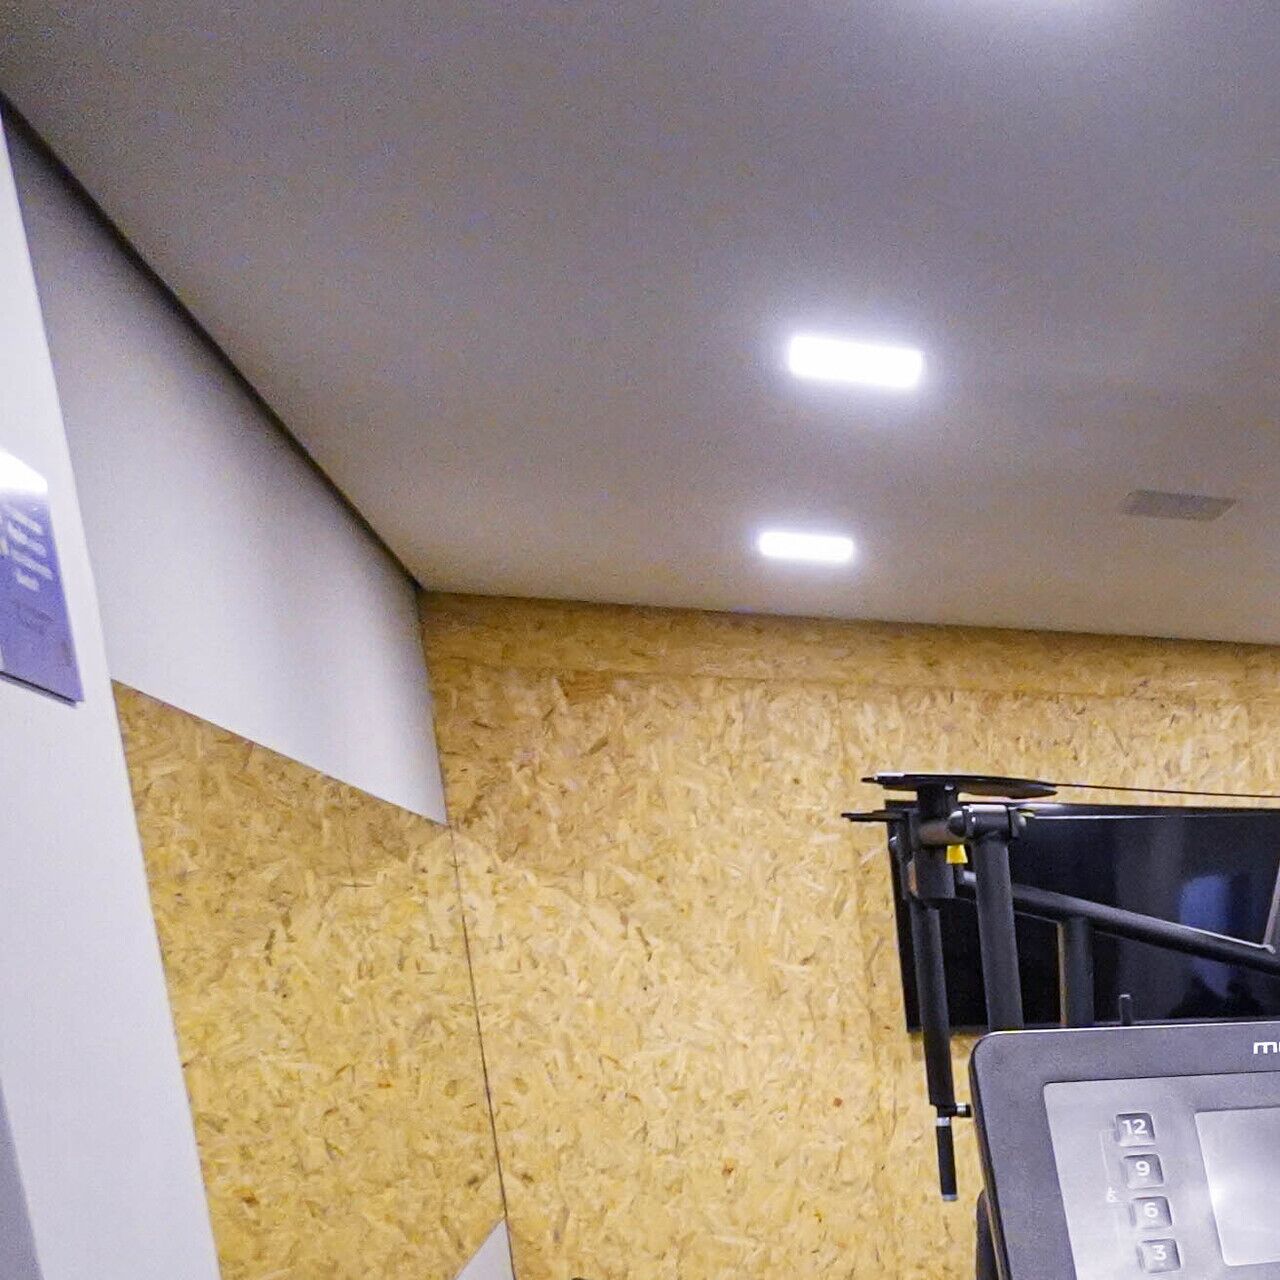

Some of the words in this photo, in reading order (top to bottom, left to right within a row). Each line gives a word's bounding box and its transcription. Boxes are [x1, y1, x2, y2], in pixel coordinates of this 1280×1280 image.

[1122, 1118, 1147, 1136] 12
[1136, 1160, 1151, 1177] 9
[1144, 1201, 1158, 1218] 6
[1153, 1243, 1167, 1260] 3
